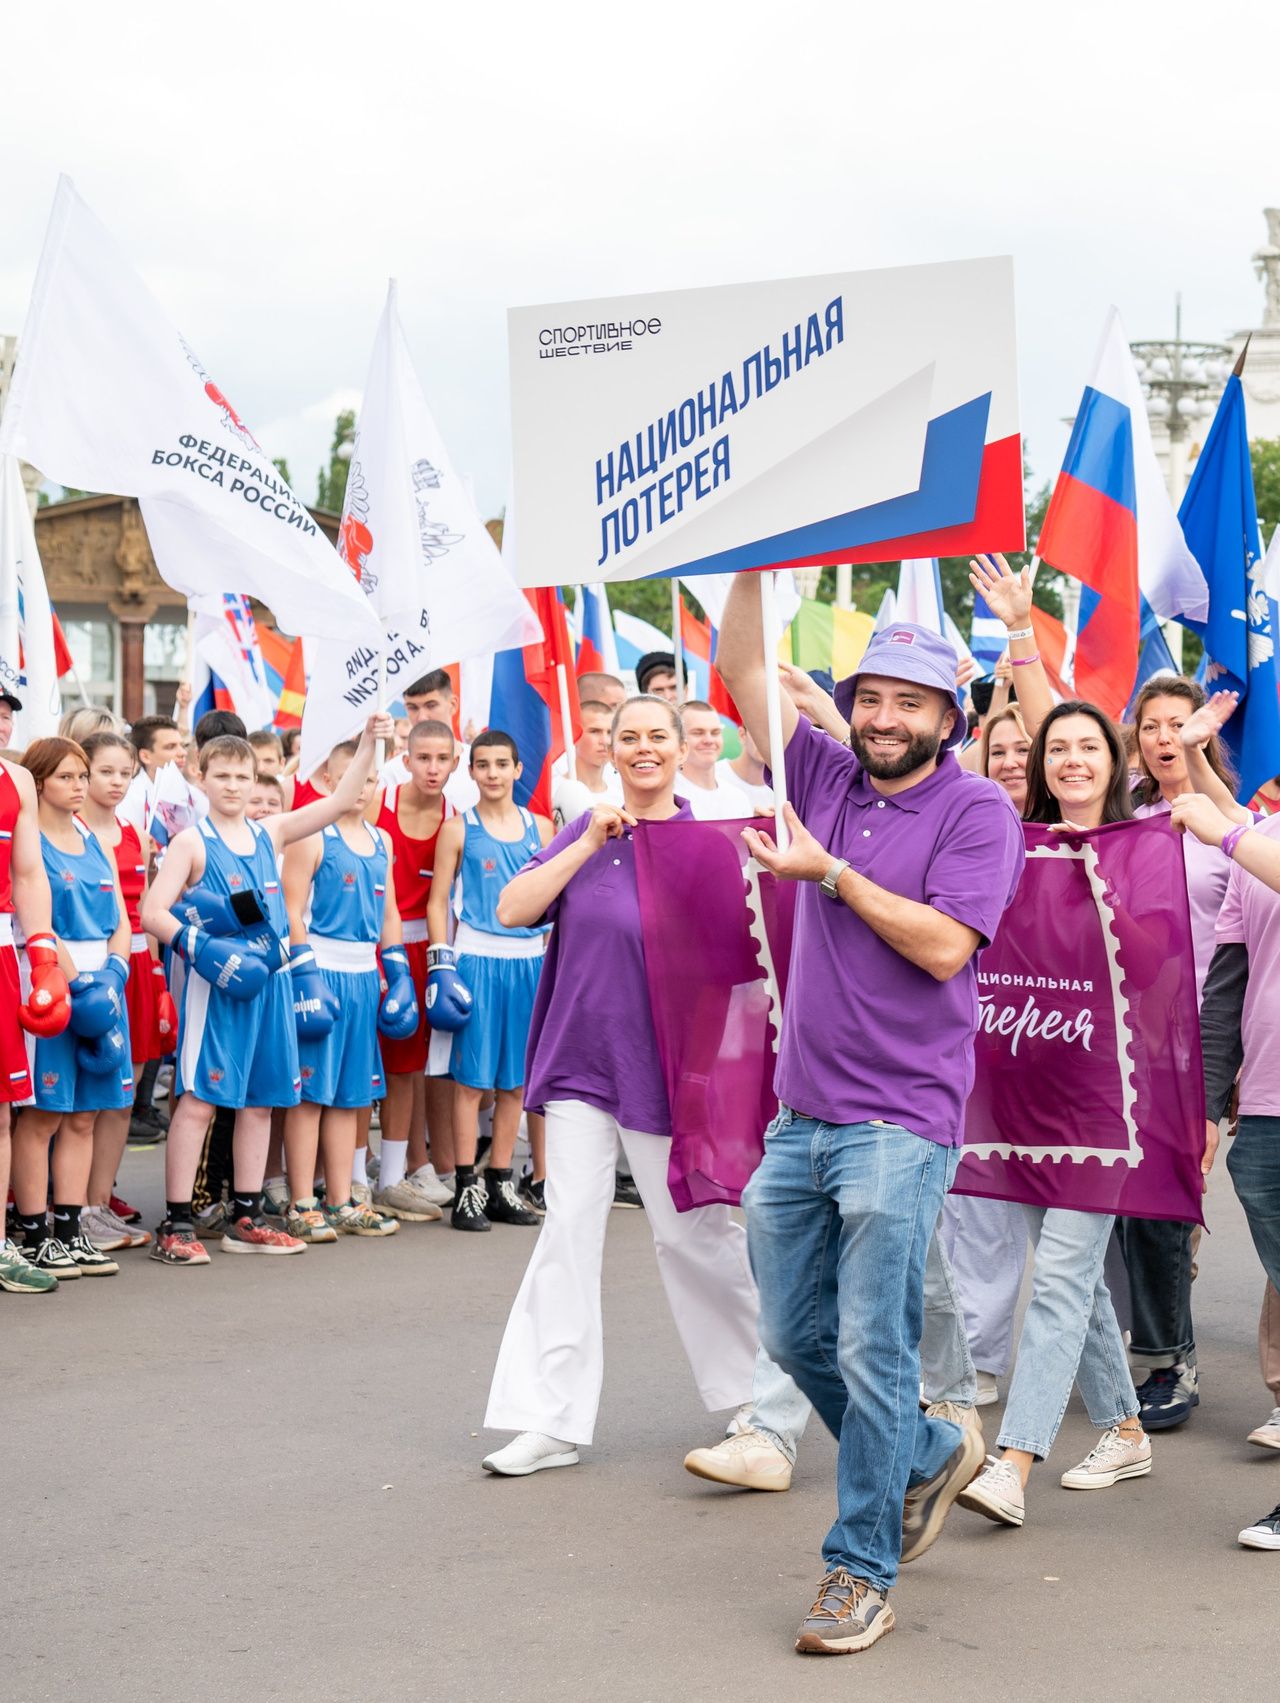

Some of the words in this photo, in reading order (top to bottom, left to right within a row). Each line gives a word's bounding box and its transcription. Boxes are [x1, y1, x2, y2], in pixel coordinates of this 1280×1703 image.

[539, 340, 633, 359] ШЕСТВИЕ
[596, 295, 844, 506] НАЦИОНАЛЬНАЯ
[151, 449, 224, 488] БОКСА
[229, 478, 317, 537] РОССИИ
[598, 434, 731, 567] ЛОТЕРЕЯ
[216, 953, 242, 989] clinch
[977, 972, 1094, 992] ЦИОНАЛЬНАЯ
[294, 997, 322, 1014] clinc
[977, 994, 1094, 1057] терея
